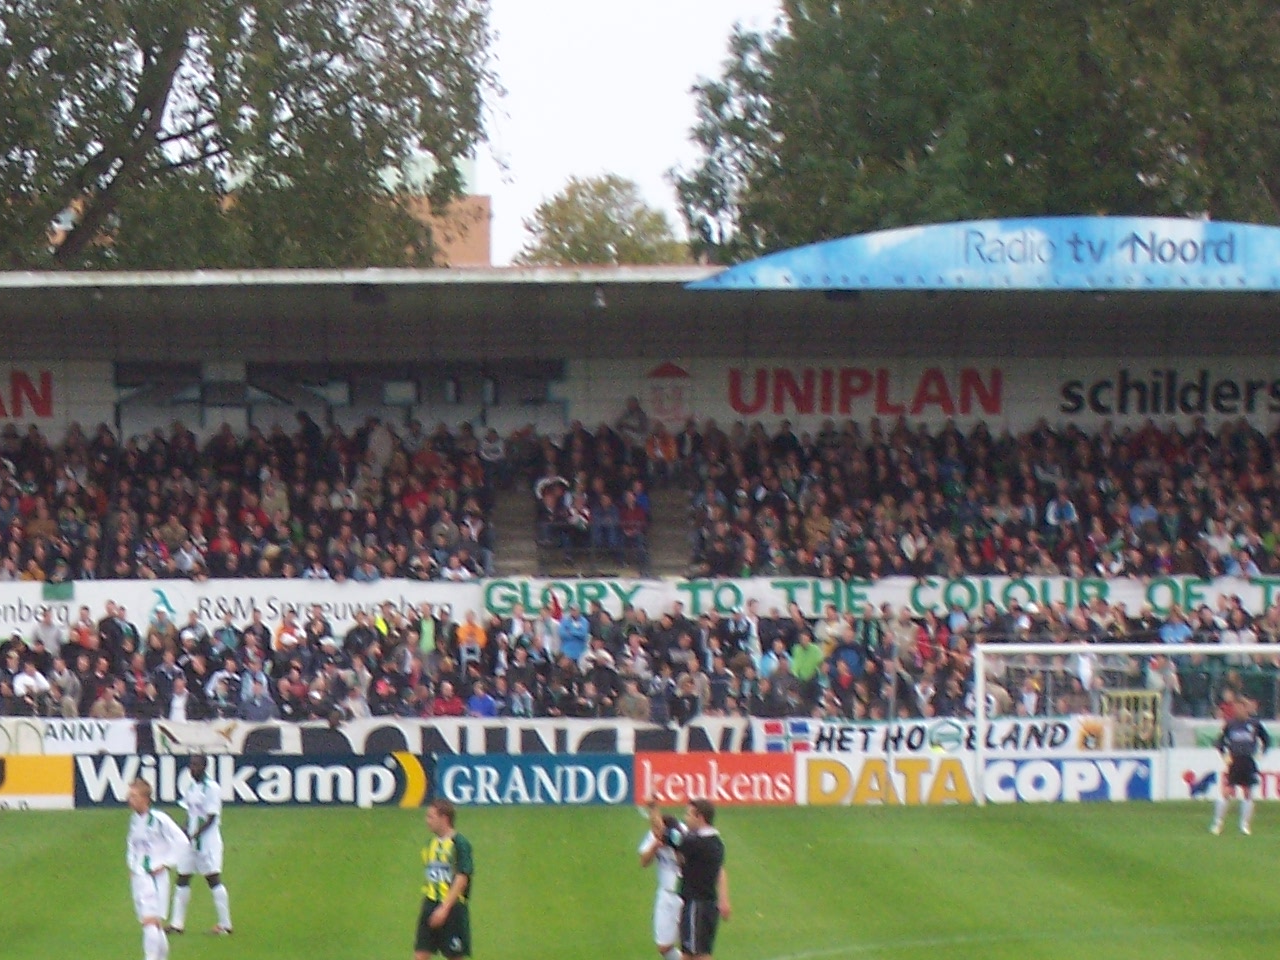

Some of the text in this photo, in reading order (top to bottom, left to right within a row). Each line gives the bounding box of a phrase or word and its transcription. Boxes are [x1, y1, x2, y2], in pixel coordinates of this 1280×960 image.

[964, 230, 1235, 265] Radio tv Noord
[727, 367, 1003, 416] UNIPLAN
[484, 579, 642, 616] GLORY
[677, 579, 744, 616] TO
[771, 577, 874, 617] THE
[910, 577, 1111, 616] COLOUR
[1147, 577, 1211, 614] OF
[815, 722, 1069, 752] HET HOELAND
[77, 753, 397, 808] Wildkamp
[442, 759, 793, 805] GRANDO keukens
[807, 757, 1139, 806] DATA COPY
